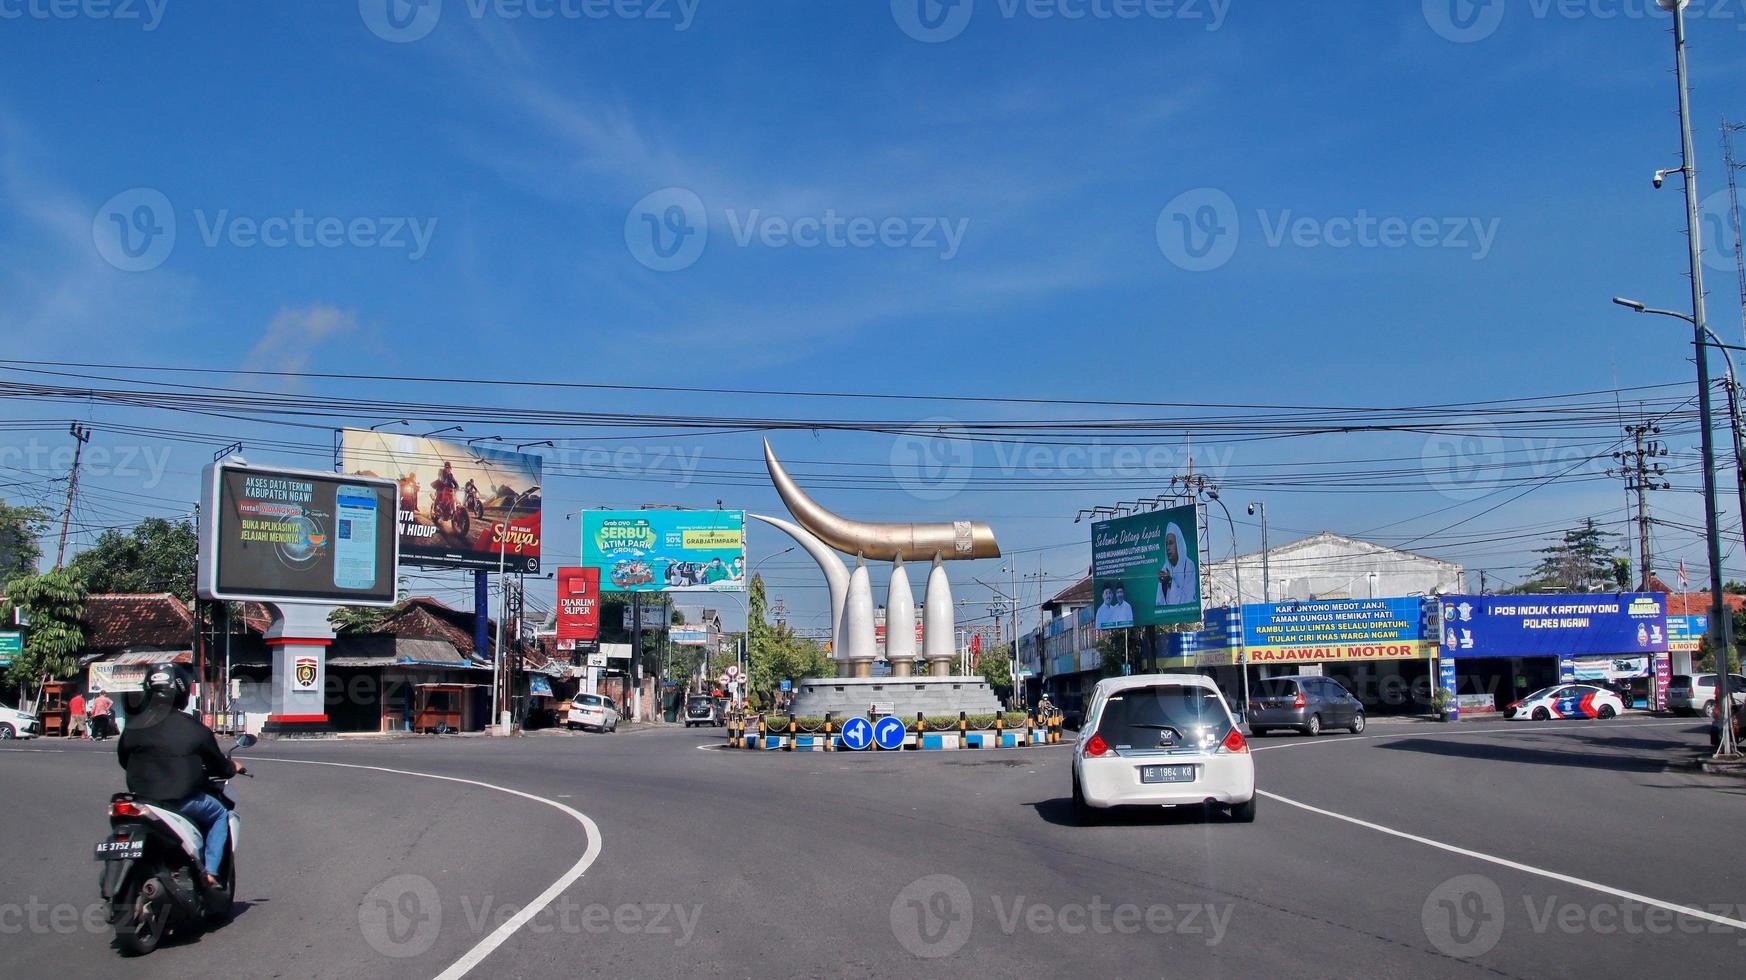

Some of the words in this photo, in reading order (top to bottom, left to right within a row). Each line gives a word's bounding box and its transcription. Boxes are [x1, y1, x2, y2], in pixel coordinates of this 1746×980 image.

[246, 477, 267, 488] AKSES
[269, 479, 287, 490] DATA
[289, 481, 313, 492] TERKINI
[245, 487, 288, 499] KABUPATEN
[289, 491, 312, 502] NGAWI
[242, 520, 259, 529] BUKA
[260, 521, 299, 532] APLIKASINYA
[407, 525, 437, 538] HIDUP
[240, 531, 268, 540] JELAJAHI
[269, 533, 298, 543] MENUNYA
[493, 523, 539, 552] Surya
[1095, 532, 1118, 548] Selamat
[1119, 529, 1141, 546] Datang
[600, 540, 626, 551] JATIM
[627, 539, 652, 550] PARK
[560, 598, 595, 607] DJARUM
[1332, 602, 1358, 611] MEDOT
[1361, 602, 1387, 611] JANJI,
[564, 607, 591, 615] SUPER
[1495, 606, 1516, 615] POS
[1517, 605, 1549, 615] INDUK
[1551, 604, 1619, 615] KARTONYONO
[1271, 614, 1298, 623] TAMAN
[1300, 612, 1333, 622] DUNGUS
[1335, 611, 1371, 620] MEMIKAT
[1374, 611, 1393, 619] HATI
[1523, 618, 1559, 629] POLRES
[1560, 617, 1590, 628] NGAWI
[1256, 626, 1284, 634] RAMBU
[1285, 625, 1305, 633] LALU
[1307, 623, 1335, 632] LINTAS
[1337, 622, 1368, 630] SELALU
[1370, 620, 1409, 630] DIPATUHI,
[1267, 635, 1297, 643] ITULAH
[1298, 634, 1315, 642] CIRI
[1316, 632, 1338, 641] KHAS
[1340, 631, 1369, 640] WARGA
[1371, 631, 1398, 639] NGAWI
[1252, 647, 1341, 661] RAJAWALI
[1347, 645, 1412, 658] MOTOR
[1145, 769, 1155, 777] AE
[1160, 767, 1177, 776] 1964
[97, 843, 108, 852] AE
[110, 842, 129, 850] 3752
